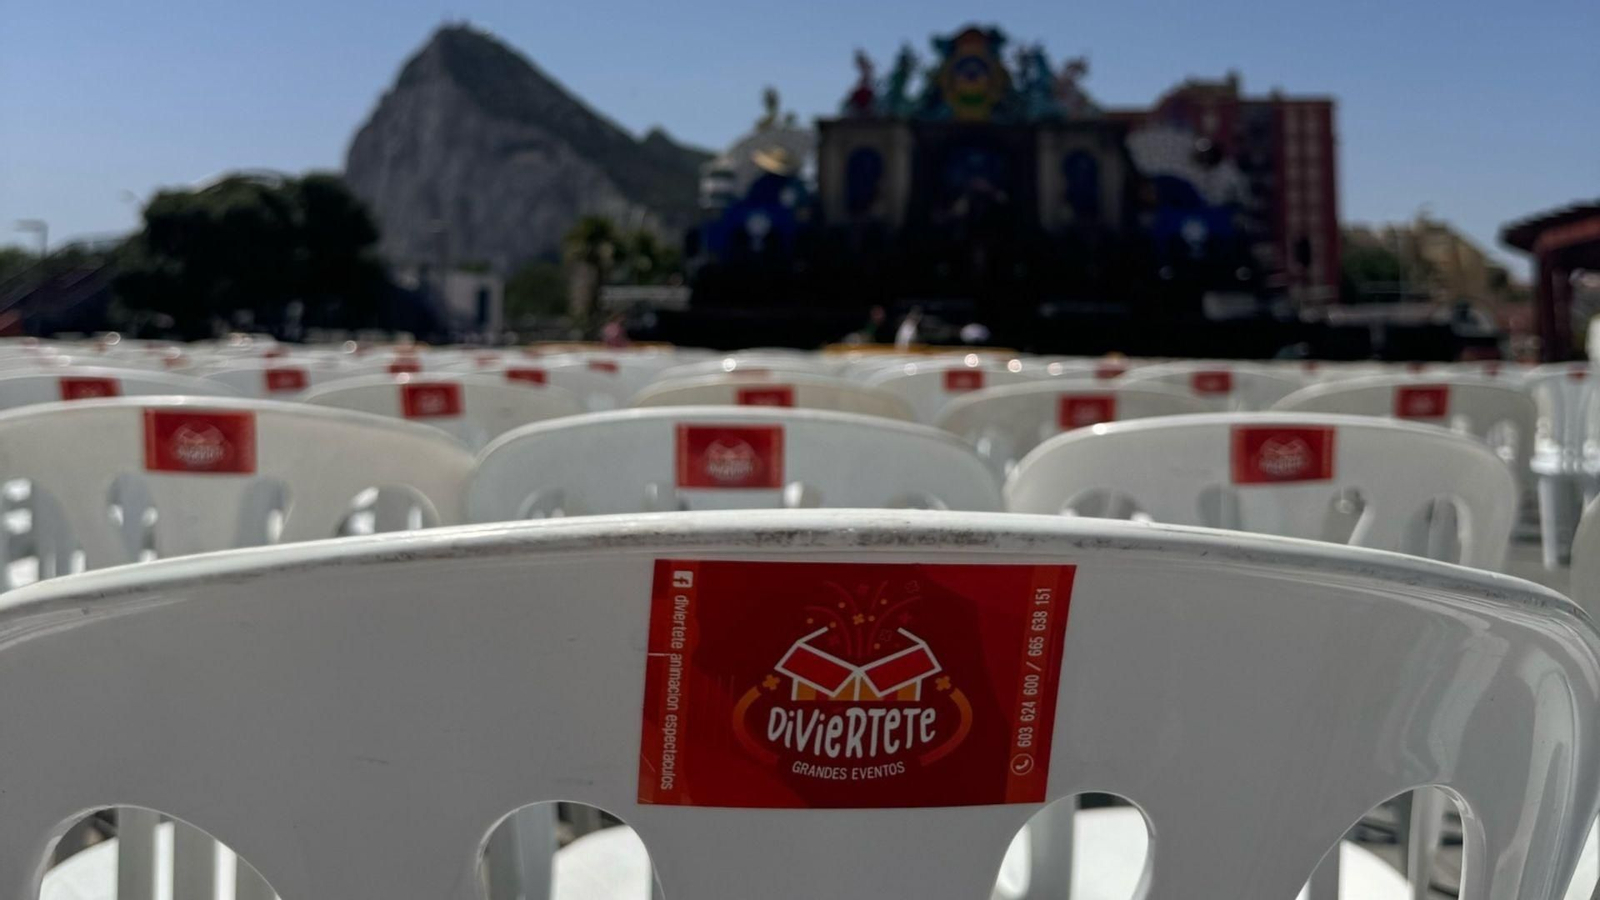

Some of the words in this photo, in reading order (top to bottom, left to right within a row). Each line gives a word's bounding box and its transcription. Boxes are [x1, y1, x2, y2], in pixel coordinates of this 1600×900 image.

[1035, 587, 1052, 605] 151
[671, 595, 689, 649] diviertete
[1031, 611, 1048, 631] 638
[1028, 636, 1044, 656] 665
[667, 653, 682, 711] animacion
[1023, 674, 1039, 695] 600
[1020, 701, 1036, 722] 624
[767, 706, 936, 758] DiVieRTeTe
[1017, 726, 1033, 747] 603
[661, 714, 678, 790] espectaculos
[792, 760, 847, 780] GRANDES
[852, 761, 905, 780] EVENTOS
